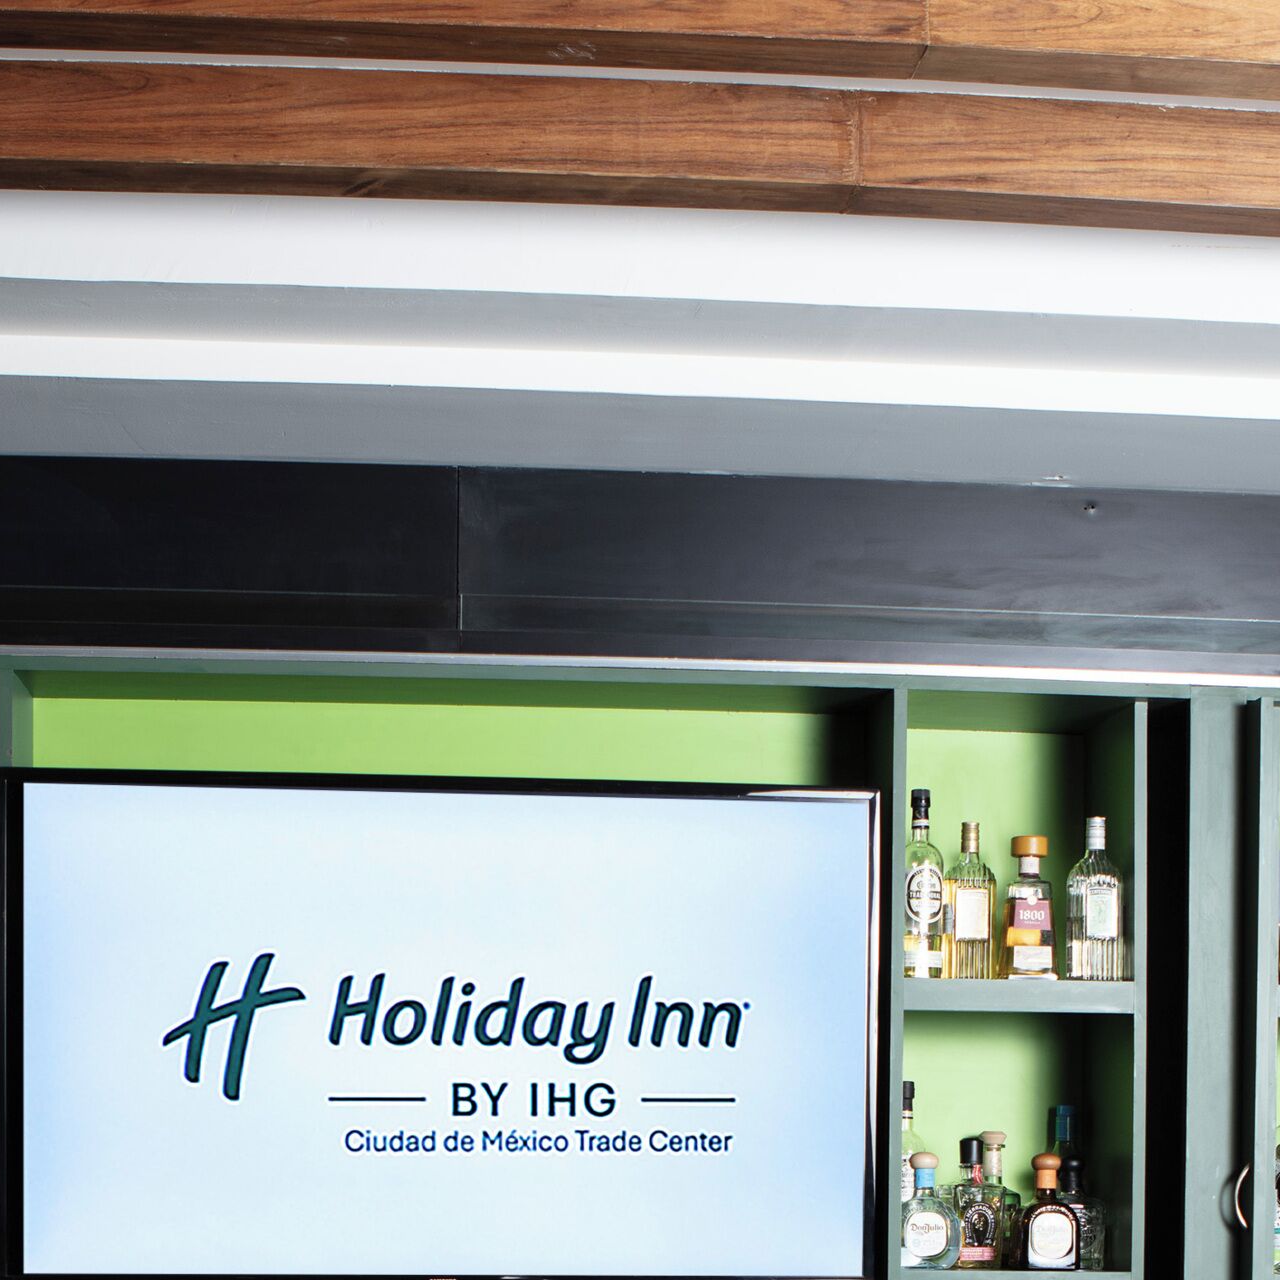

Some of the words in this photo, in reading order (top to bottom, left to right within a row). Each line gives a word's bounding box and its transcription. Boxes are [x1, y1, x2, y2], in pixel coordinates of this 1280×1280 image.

[1019, 910, 1045, 921] 1800
[328, 972, 616, 1065] Holiday
[628, 975, 746, 1048] Inn
[451, 1081, 509, 1117] BY
[530, 1081, 617, 1118] IHG
[344, 1129, 437, 1153] Ciudad
[443, 1130, 475, 1153] de
[481, 1129, 569, 1153] México
[575, 1130, 642, 1153] Trade
[648, 1129, 734, 1153] Center
